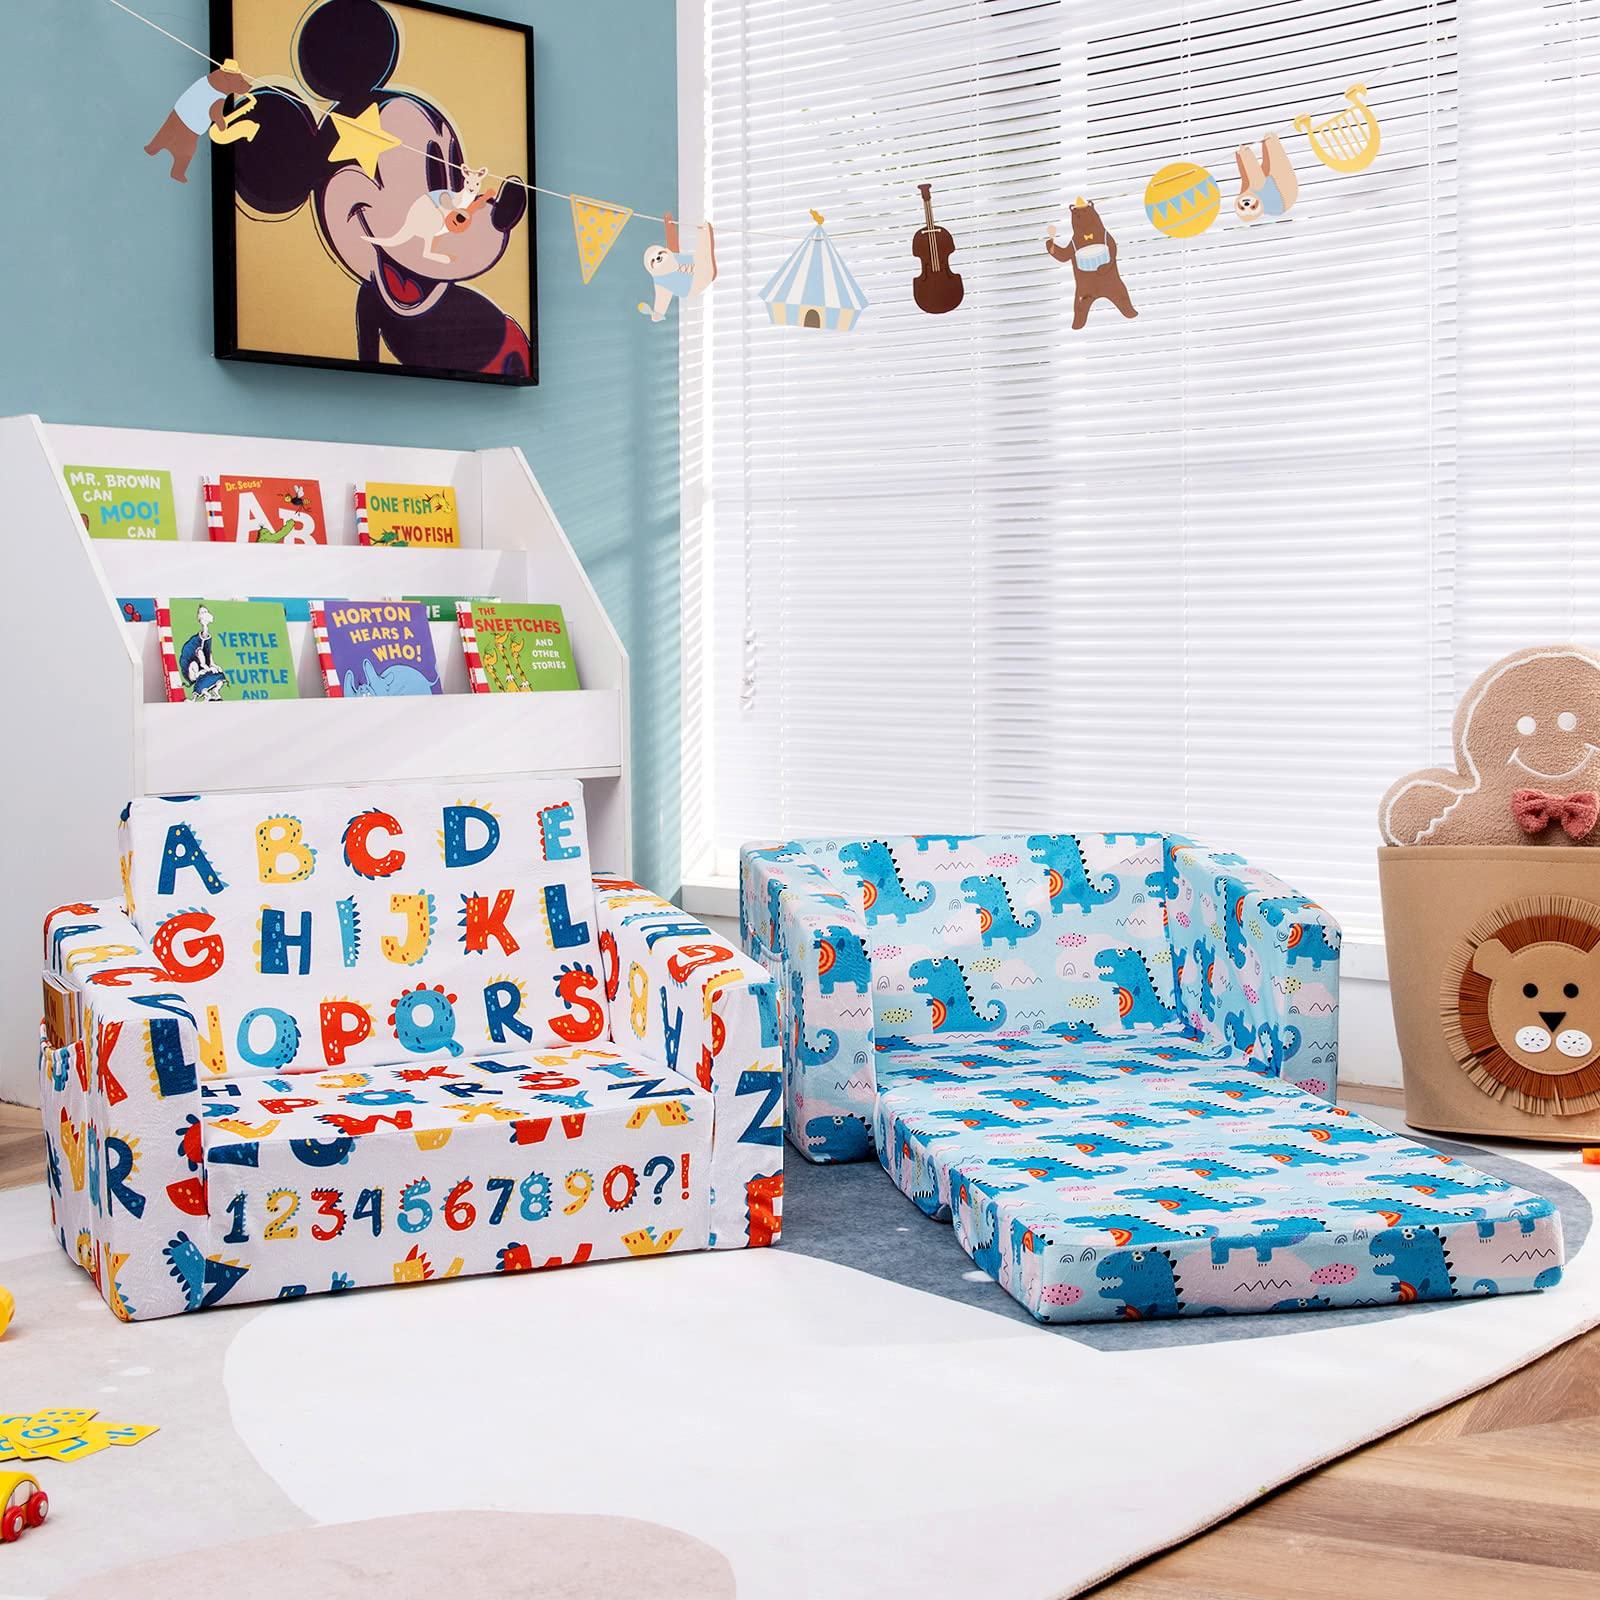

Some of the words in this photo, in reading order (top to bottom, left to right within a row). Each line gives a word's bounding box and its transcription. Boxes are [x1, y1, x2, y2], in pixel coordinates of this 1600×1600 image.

[70, 471, 101, 487] MR.
[105, 474, 161, 490] BROWN
[225, 481, 238, 492] Dr.
[82, 489, 113, 503] CAN
[100, 501, 161, 526] MOO!
[370, 495, 399, 513] ONE
[403, 498, 433, 515] FISH
[127, 526, 157, 539] CAN
[391, 524, 423, 542] TWO
[424, 526, 454, 544] FISH
[331, 606, 412, 629] HORTON
[477, 607, 497, 616] THE
[349, 626, 400, 644] HEARS
[403, 626, 415, 640] A
[474, 618, 562, 635] SNEETCHES
[217, 631, 279, 649] YERTLE
[535, 638, 554, 647] AND
[235, 652, 270, 665] THE
[371, 643, 422, 662] WHO!
[532, 649, 561, 659] OTHER
[532, 660, 567, 670] STORIES
[225, 668, 289, 685] TURTLE
[241, 689, 269, 700] AND
[158, 821, 227, 895] A
[255, 813, 317, 884] B
[342, 807, 406, 879] C
[437, 799, 501, 868] D
[537, 801, 581, 861] E
[150, 907, 224, 983] G
[255, 904, 312, 975] H
[458, 889, 520, 956] K
[540, 884, 590, 950] L
[320, 994, 375, 1066] P
[390, 982, 464, 1057] Q
[483, 974, 533, 1043] R
[548, 963, 604, 1042] S
